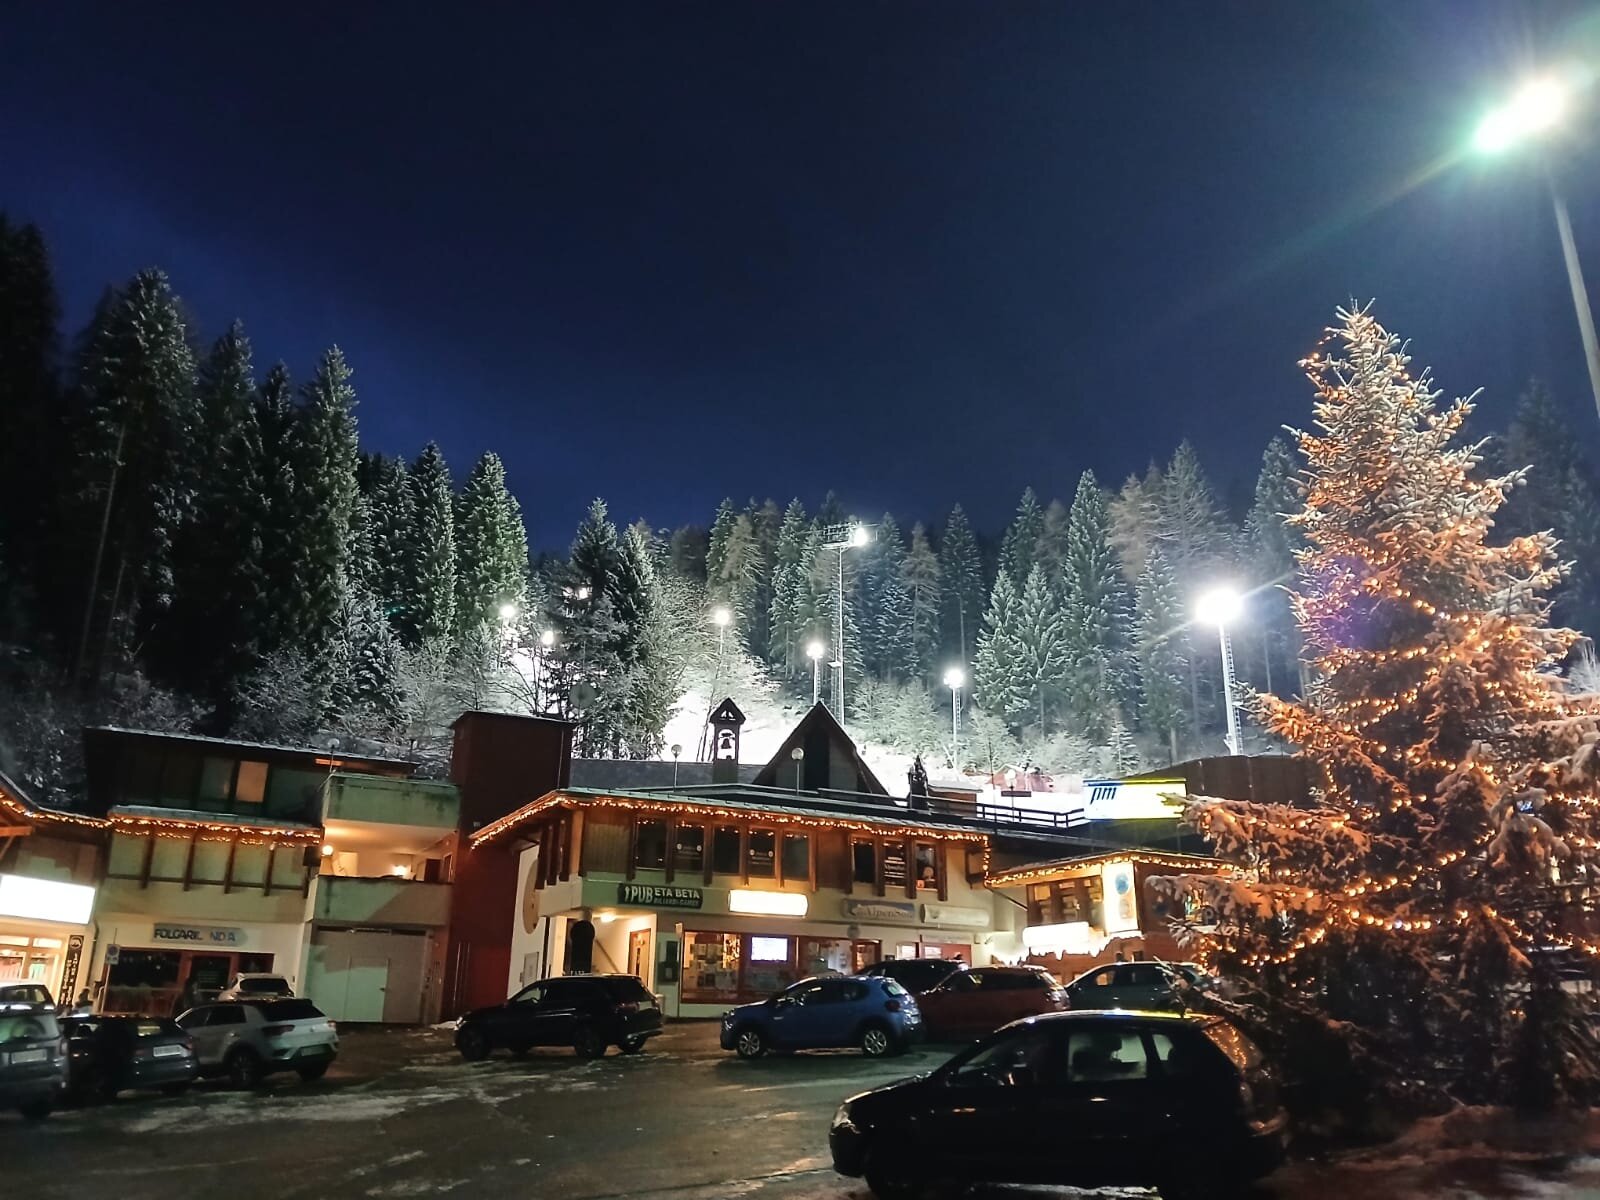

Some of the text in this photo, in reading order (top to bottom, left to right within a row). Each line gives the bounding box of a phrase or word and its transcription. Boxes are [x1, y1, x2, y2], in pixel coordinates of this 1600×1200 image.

[631, 885, 653, 904] PUB
[654, 887, 700, 899] ETA BETA
